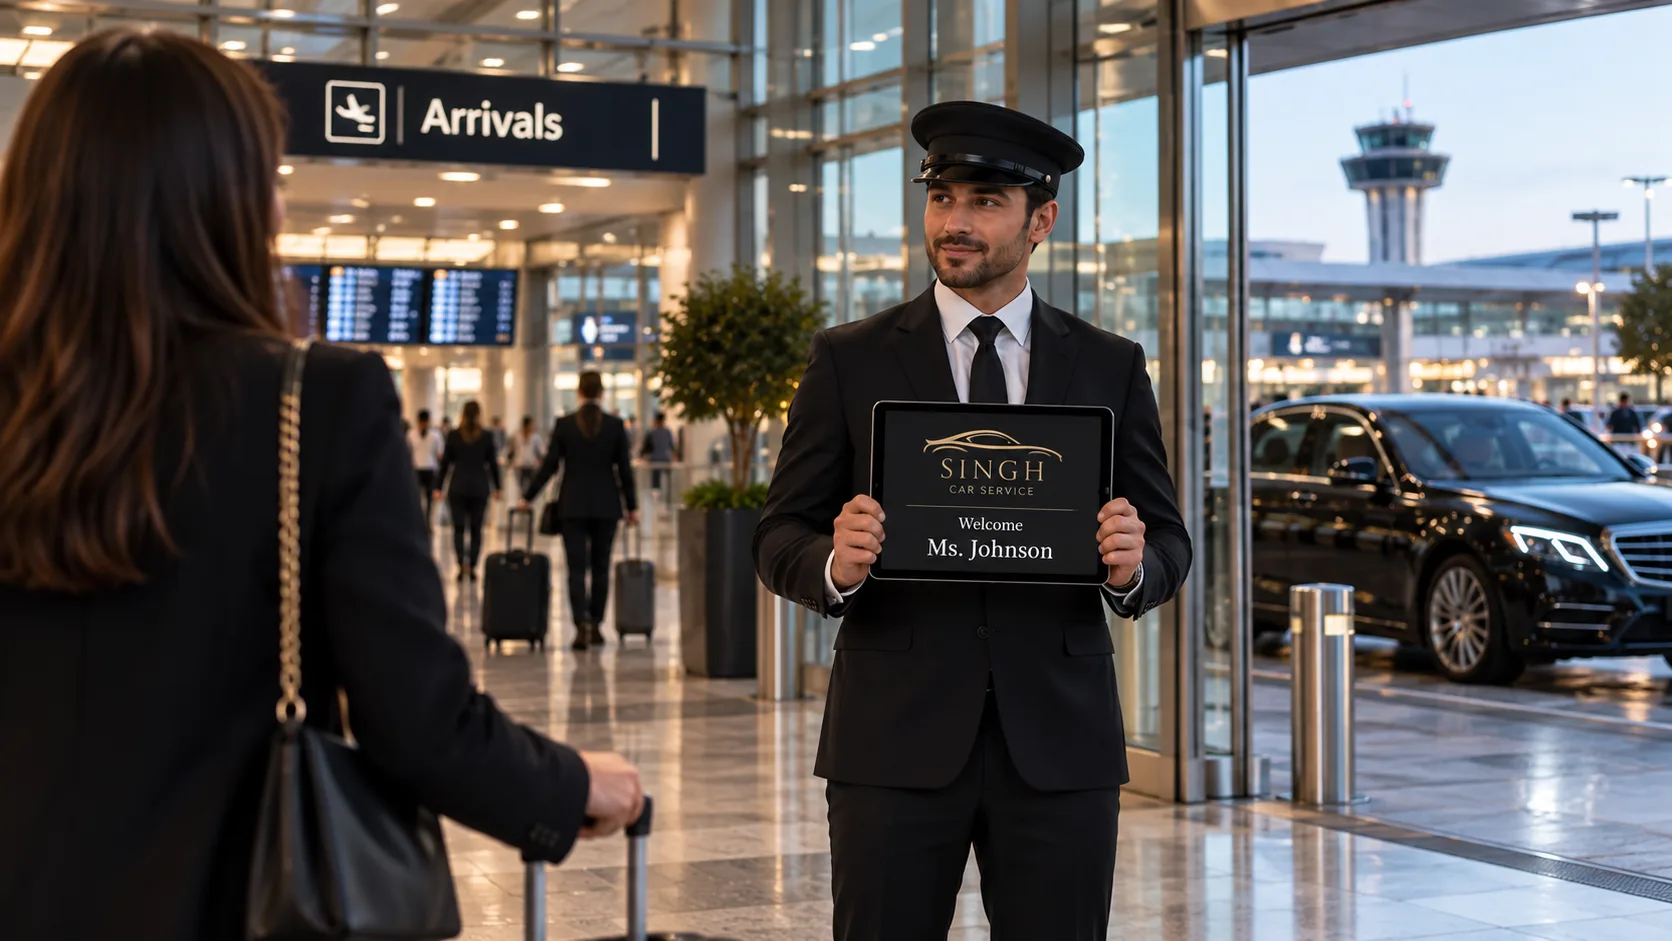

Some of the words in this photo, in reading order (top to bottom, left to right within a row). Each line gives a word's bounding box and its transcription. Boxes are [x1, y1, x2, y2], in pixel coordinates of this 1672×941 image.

[420, 98, 563, 141] Arrivals
[941, 458, 1043, 481] SINGH
[949, 485, 975, 494] CAR
[980, 486, 1034, 496] SERVICE
[958, 517, 1023, 531] Welcome
[927, 538, 963, 557] Ms.
[968, 539, 1053, 561] Johnson
